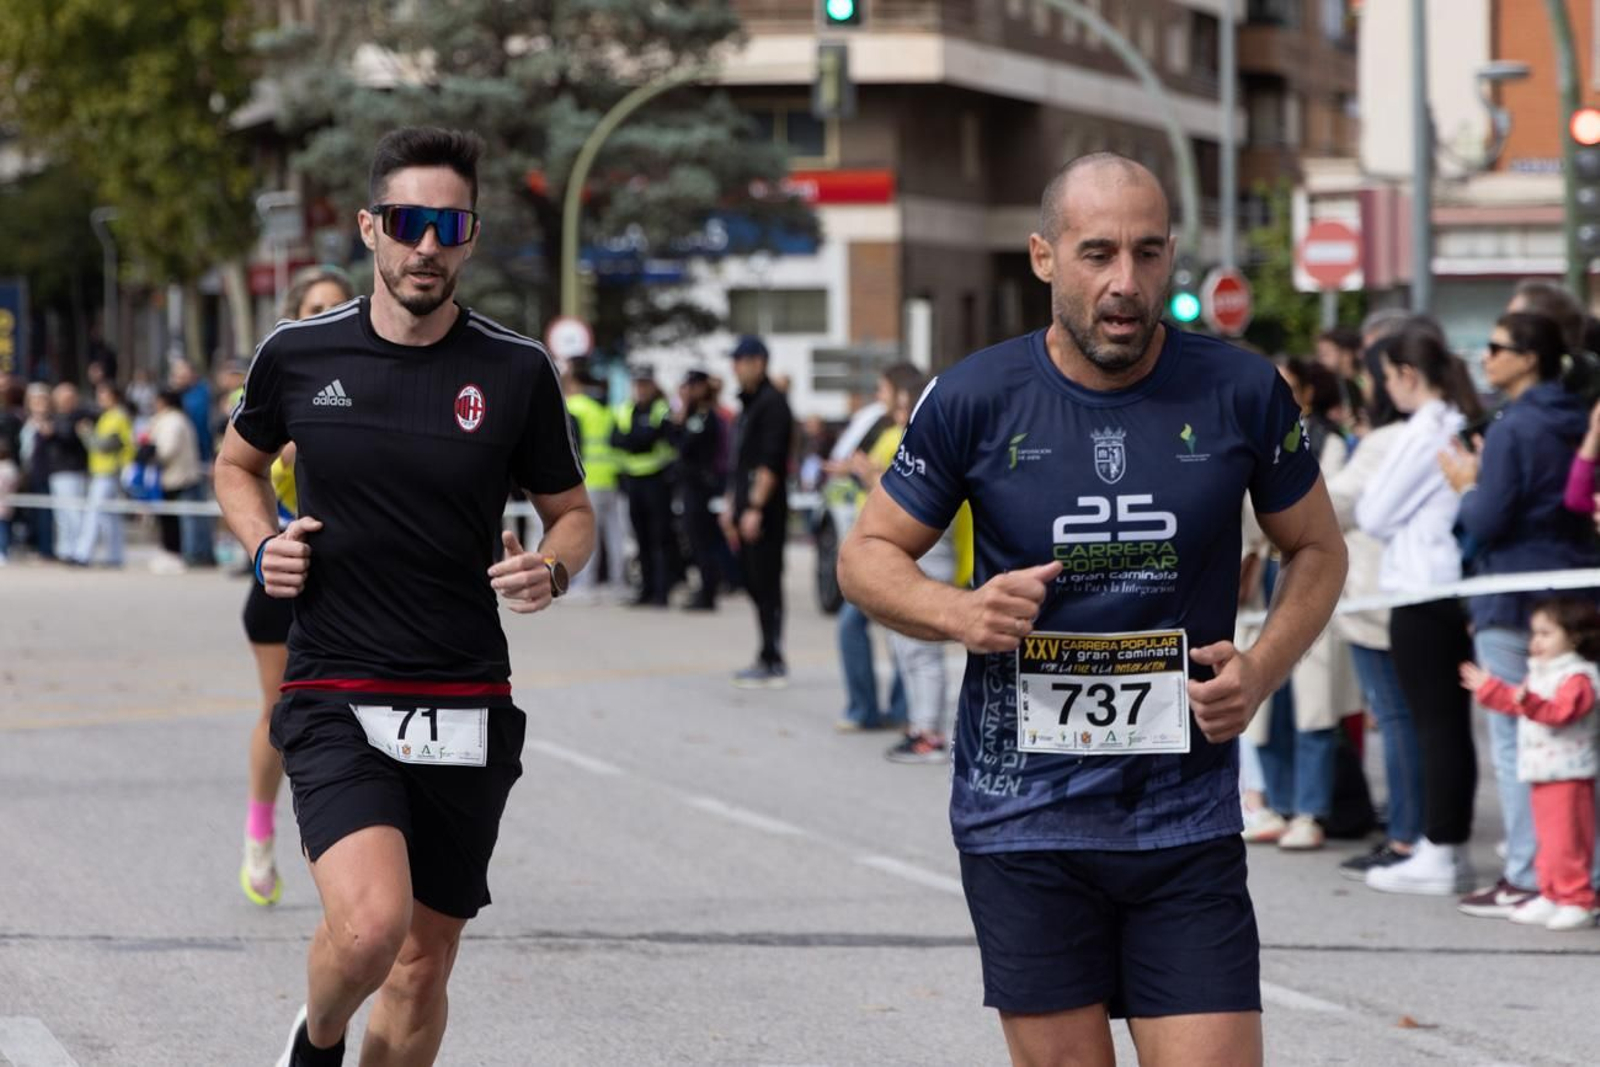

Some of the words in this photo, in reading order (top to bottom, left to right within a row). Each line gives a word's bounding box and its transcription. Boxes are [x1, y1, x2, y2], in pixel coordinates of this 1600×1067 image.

[312, 395, 353, 407] adidas
[1052, 493, 1178, 544] 25
[1053, 541, 1176, 559] CARRERA
[1061, 555, 1179, 572] POPULAR
[1070, 571, 1105, 584] gran
[1109, 569, 1178, 581] caminata
[1110, 581, 1120, 593] la
[1023, 638, 1060, 661] XXV
[1061, 640, 1119, 651] CARRERA
[1121, 637, 1178, 650] POPULAR
[1061, 650, 1071, 661] y
[1077, 650, 1110, 662] gran
[1117, 647, 1178, 660] caminata
[1051, 681, 1152, 727] 737
[391, 706, 438, 741] 71
[983, 700, 1001, 765] SANTA
[1002, 739, 1019, 768] DE
[968, 765, 1022, 798] JAÉN
